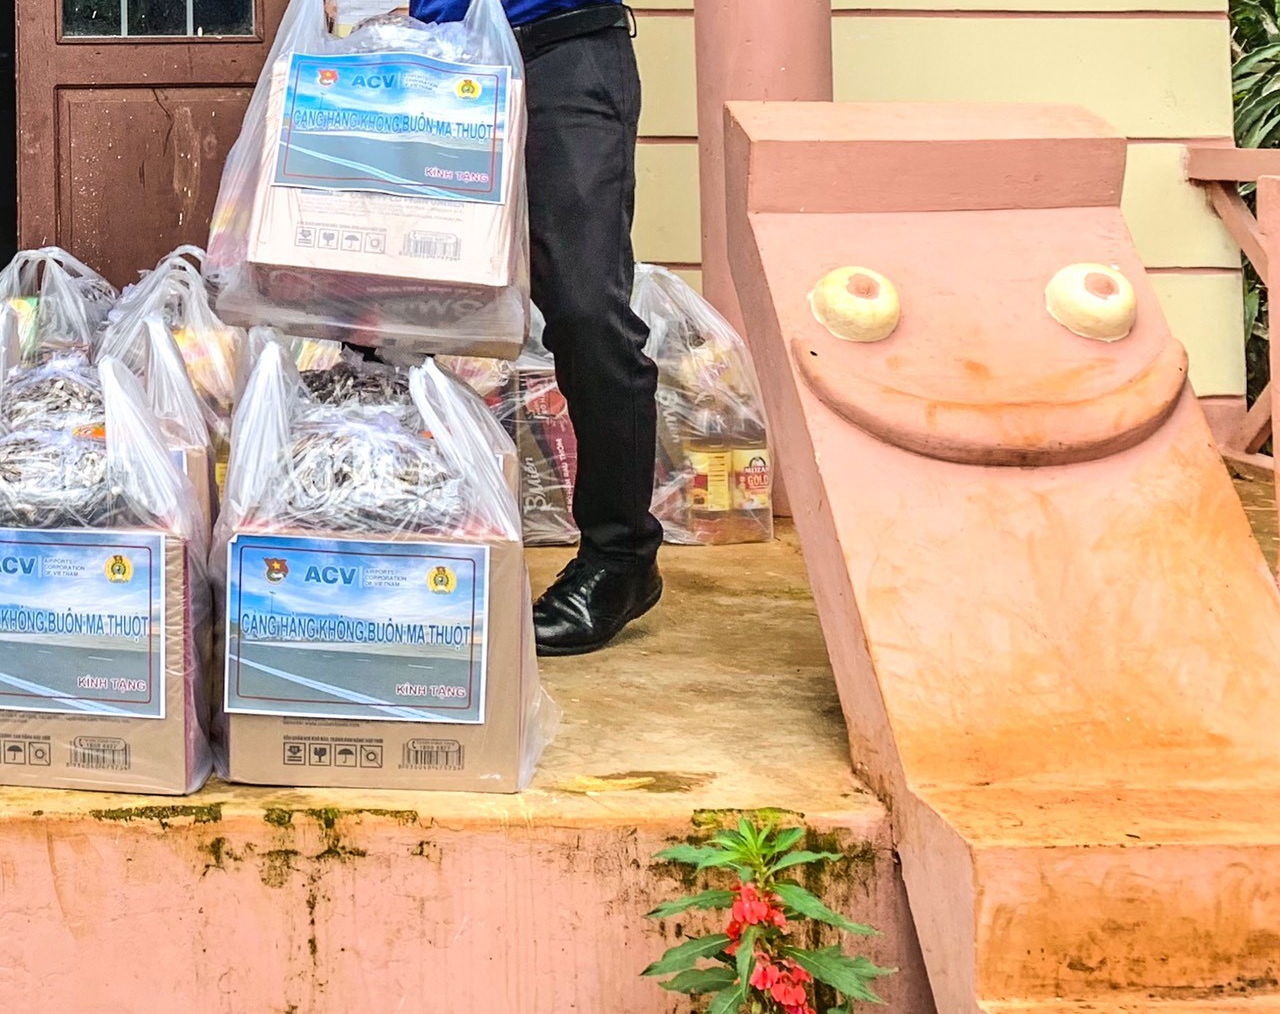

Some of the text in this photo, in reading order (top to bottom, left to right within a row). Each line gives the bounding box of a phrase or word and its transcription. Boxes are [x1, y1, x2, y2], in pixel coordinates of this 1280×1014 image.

[352, 75, 396, 88] ACV
[436, 121, 452, 136] MA
[748, 474, 769, 486] GOLD
[304, 566, 356, 584] ACV
[48, 608, 83, 633] BUÔN
[87, 614, 104, 634] MA
[370, 618, 403, 643] BUÔN
[407, 624, 425, 644] MA
[77, 675, 107, 689] KÍNH
[396, 682, 426, 696] KÍNH
